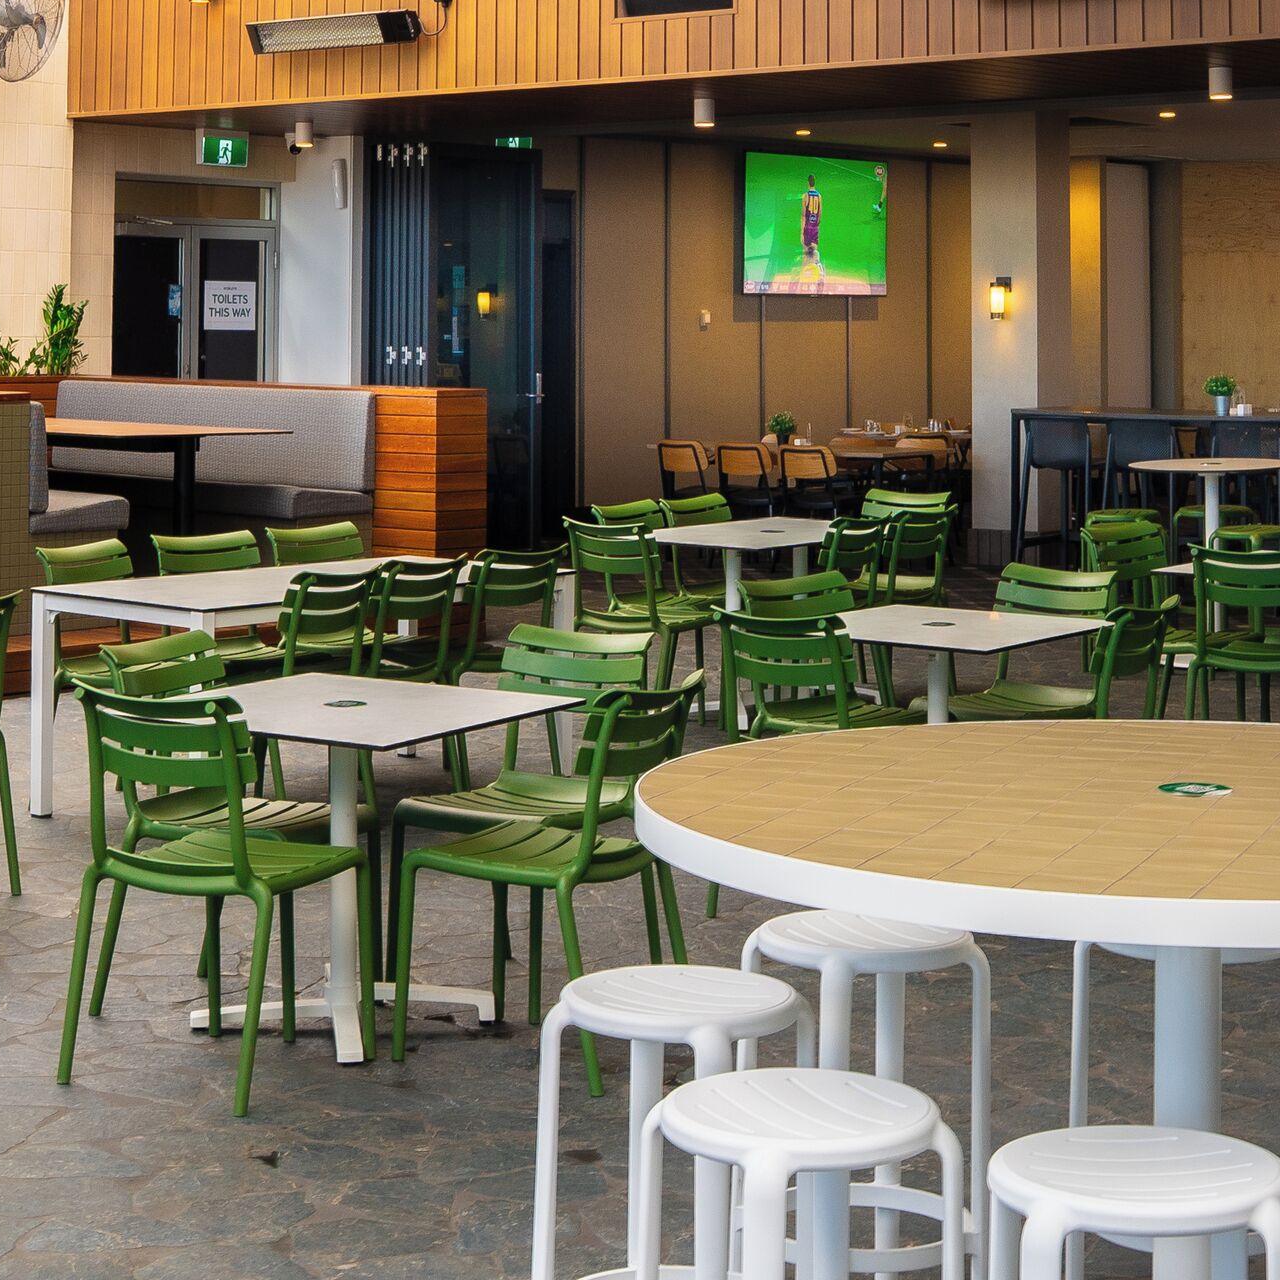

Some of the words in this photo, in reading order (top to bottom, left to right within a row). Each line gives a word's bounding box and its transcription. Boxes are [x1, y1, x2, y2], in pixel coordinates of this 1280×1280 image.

[212, 294, 248, 304] TOILETS
[209, 307, 230, 317] THIS
[232, 308, 251, 317] WAY
